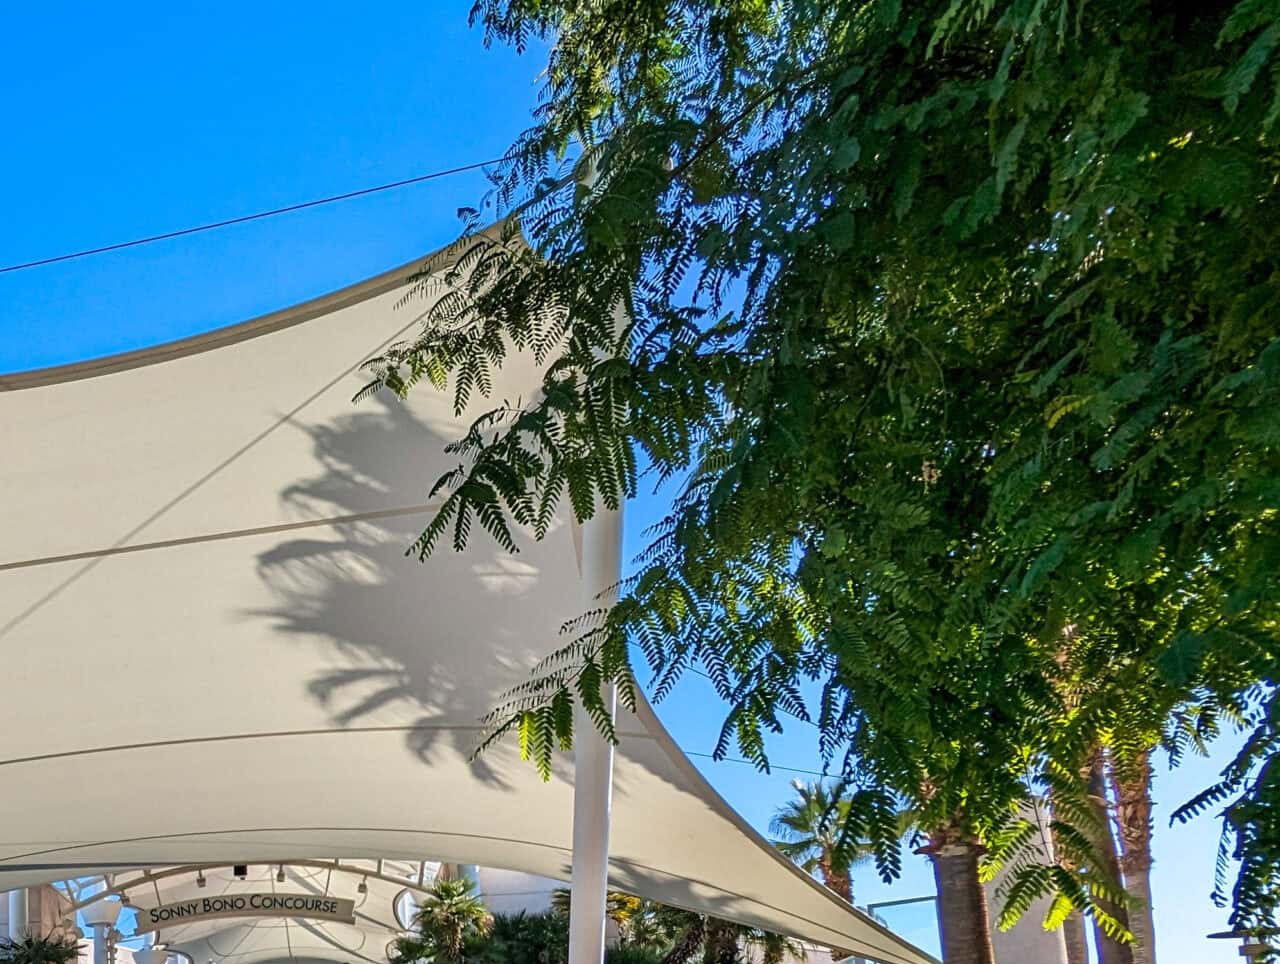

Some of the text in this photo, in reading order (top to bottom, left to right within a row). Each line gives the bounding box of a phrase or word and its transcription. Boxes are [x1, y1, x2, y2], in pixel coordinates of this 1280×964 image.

[150, 894, 338, 923] SONNY BONO CONCOURSE
